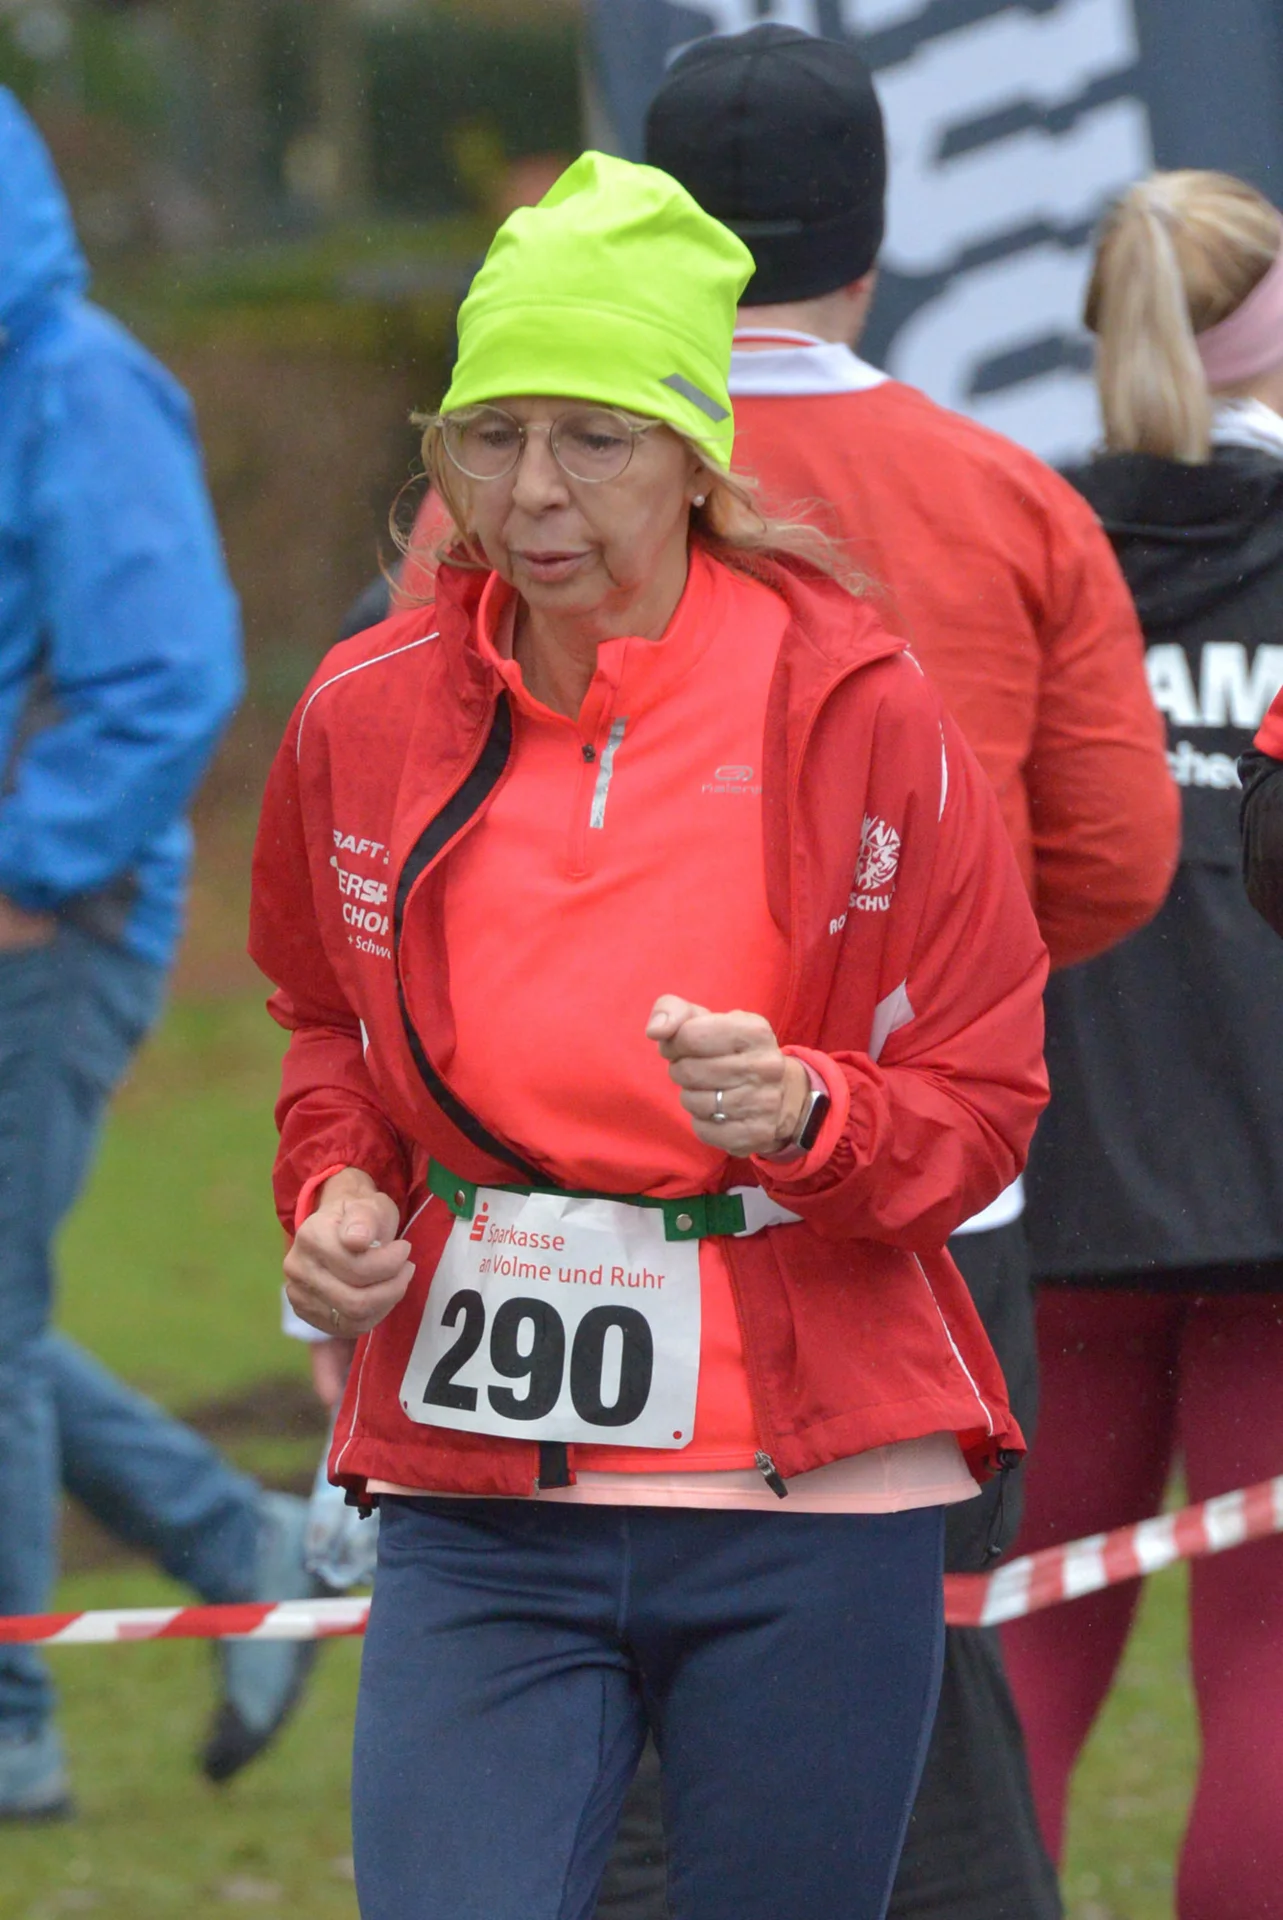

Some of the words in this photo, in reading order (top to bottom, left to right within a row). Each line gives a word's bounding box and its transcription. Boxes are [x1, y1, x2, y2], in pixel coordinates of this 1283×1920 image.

[829, 911, 848, 935] RO
[848, 891, 893, 912] SCHU
[487, 1223, 566, 1251] Sparkasse
[479, 1257, 492, 1273] an
[493, 1255, 552, 1282] Volme
[558, 1264, 603, 1286] und
[610, 1265, 666, 1290] Ruhr
[422, 1288, 654, 1428] 290
